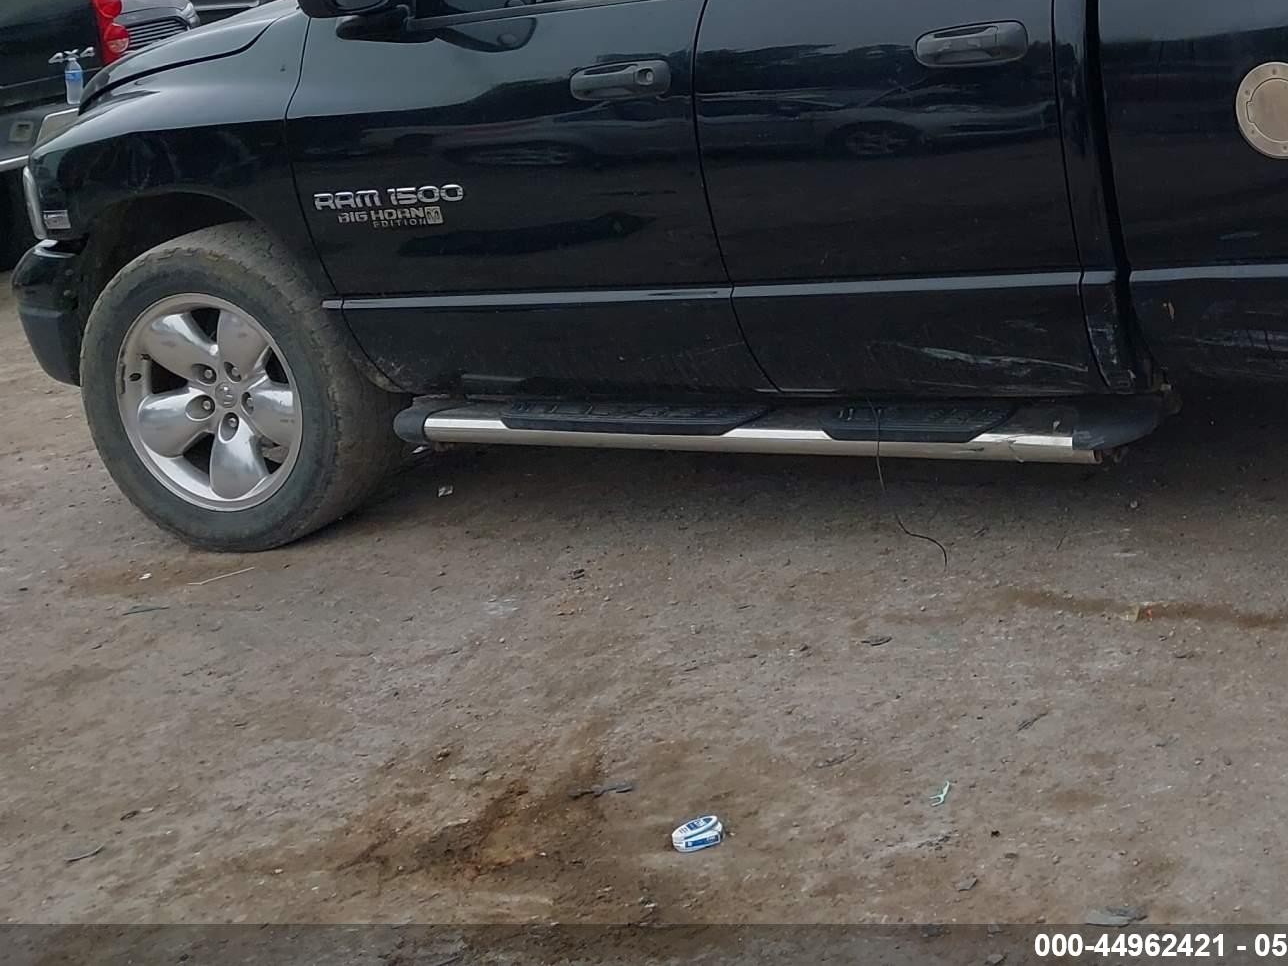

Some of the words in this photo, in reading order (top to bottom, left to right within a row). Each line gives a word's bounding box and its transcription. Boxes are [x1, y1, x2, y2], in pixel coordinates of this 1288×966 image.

[313, 189, 382, 211] RAM
[387, 184, 464, 206] 1500
[338, 211, 369, 224] BIG
[370, 207, 425, 221] HORN
[373, 218, 428, 229] EDITION
